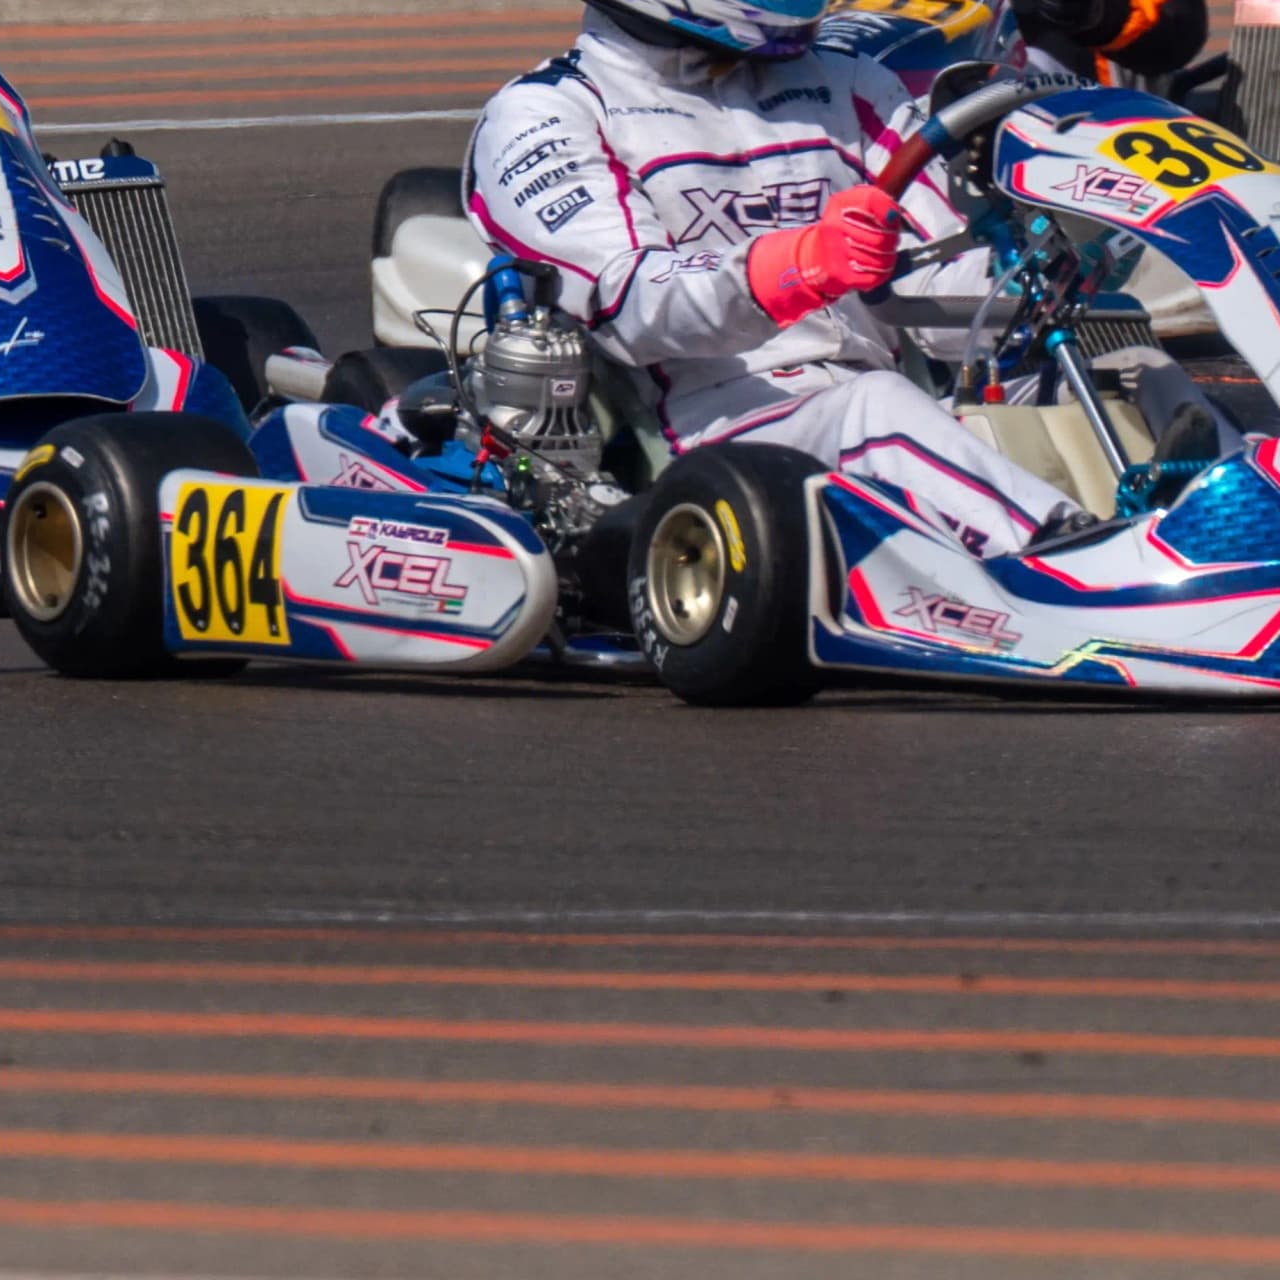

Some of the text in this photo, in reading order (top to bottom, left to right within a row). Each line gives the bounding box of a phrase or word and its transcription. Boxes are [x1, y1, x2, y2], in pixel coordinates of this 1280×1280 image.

[1049, 164, 1158, 206] XCEL
[176, 487, 285, 638] 364
[332, 540, 469, 606] XCEL
[893, 585, 1024, 643] XCEL
